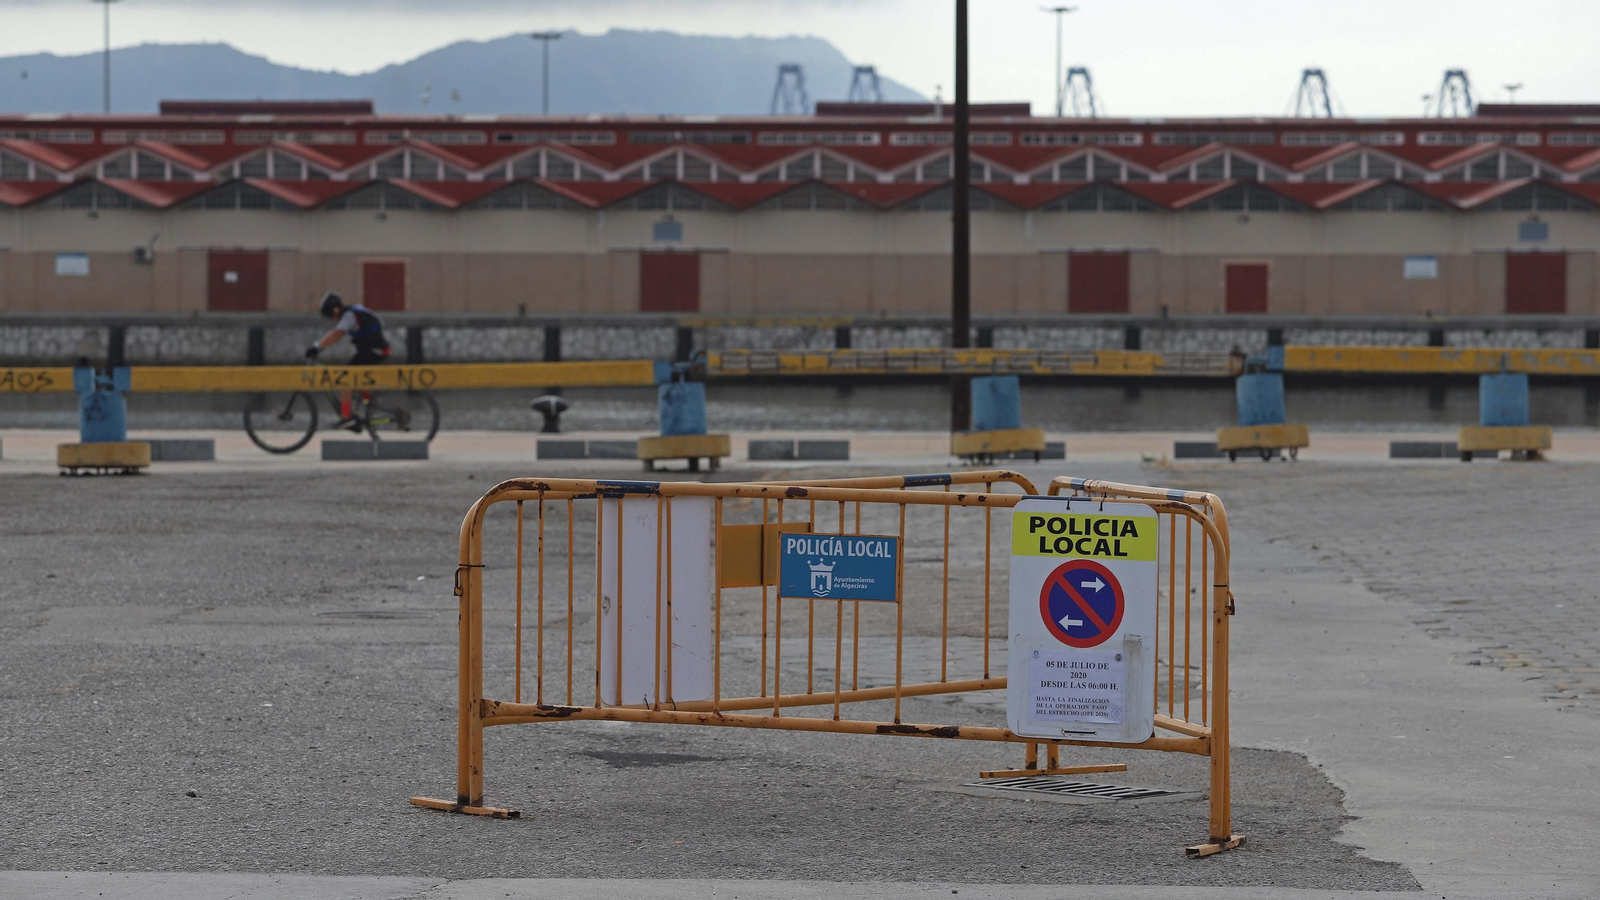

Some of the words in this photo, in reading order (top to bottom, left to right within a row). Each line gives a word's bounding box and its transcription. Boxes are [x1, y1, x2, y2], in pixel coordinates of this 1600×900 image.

[301, 368, 376, 388] NAZIS
[398, 368, 437, 388] NO
[1029, 516, 1138, 538] POLICIA
[787, 537, 843, 556] POLICÍA
[848, 540, 891, 558] LOCAL
[1039, 536, 1128, 557] LOCAL
[833, 576, 875, 584] Ayuntamiento
[1057, 661, 1068, 669] DE
[1088, 682, 1108, 690] 06:00
